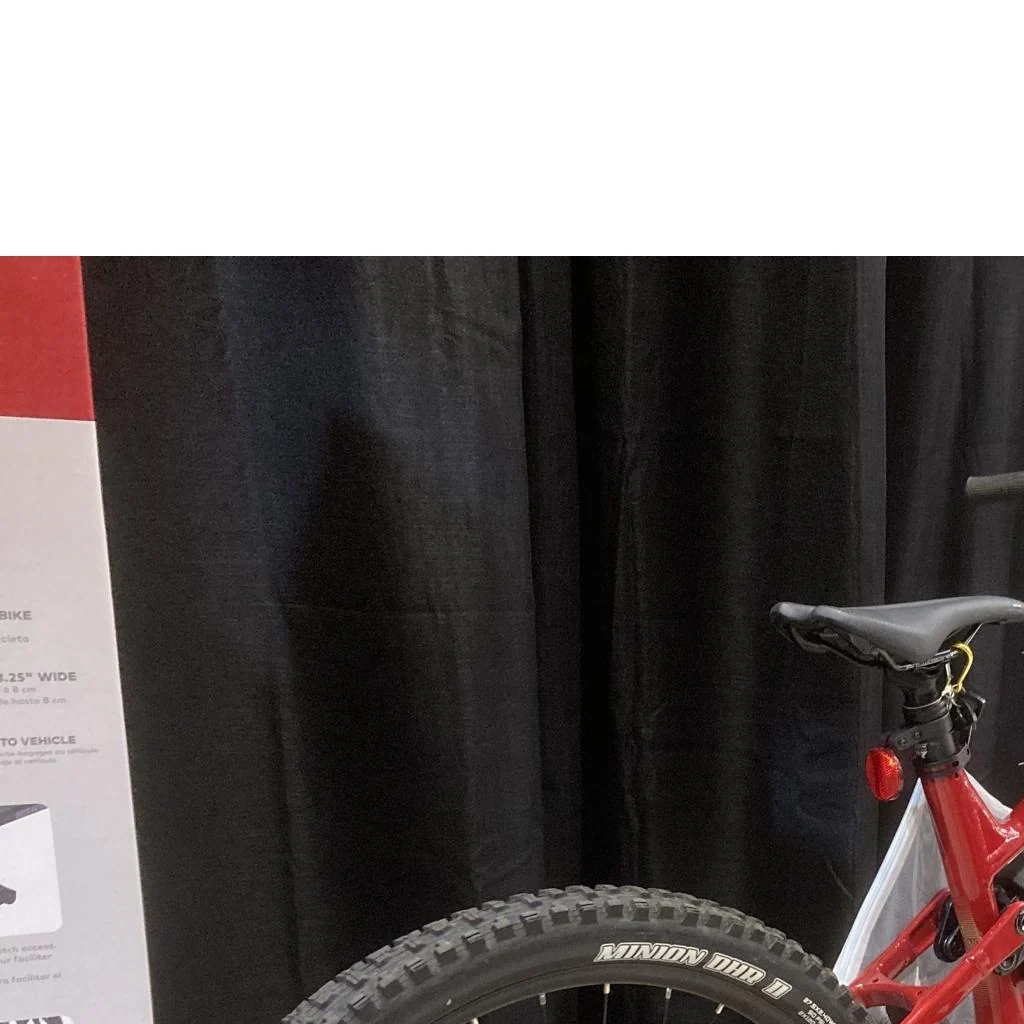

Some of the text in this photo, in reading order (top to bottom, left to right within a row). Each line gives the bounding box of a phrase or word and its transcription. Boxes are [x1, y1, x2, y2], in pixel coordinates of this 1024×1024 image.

[0, 610, 32, 620] BIKE
[38, 672, 77, 681] WIDE
[0, 735, 77, 747] TO VEHICLE
[593, 942, 708, 967] MINION
[703, 952, 766, 986] DHR
